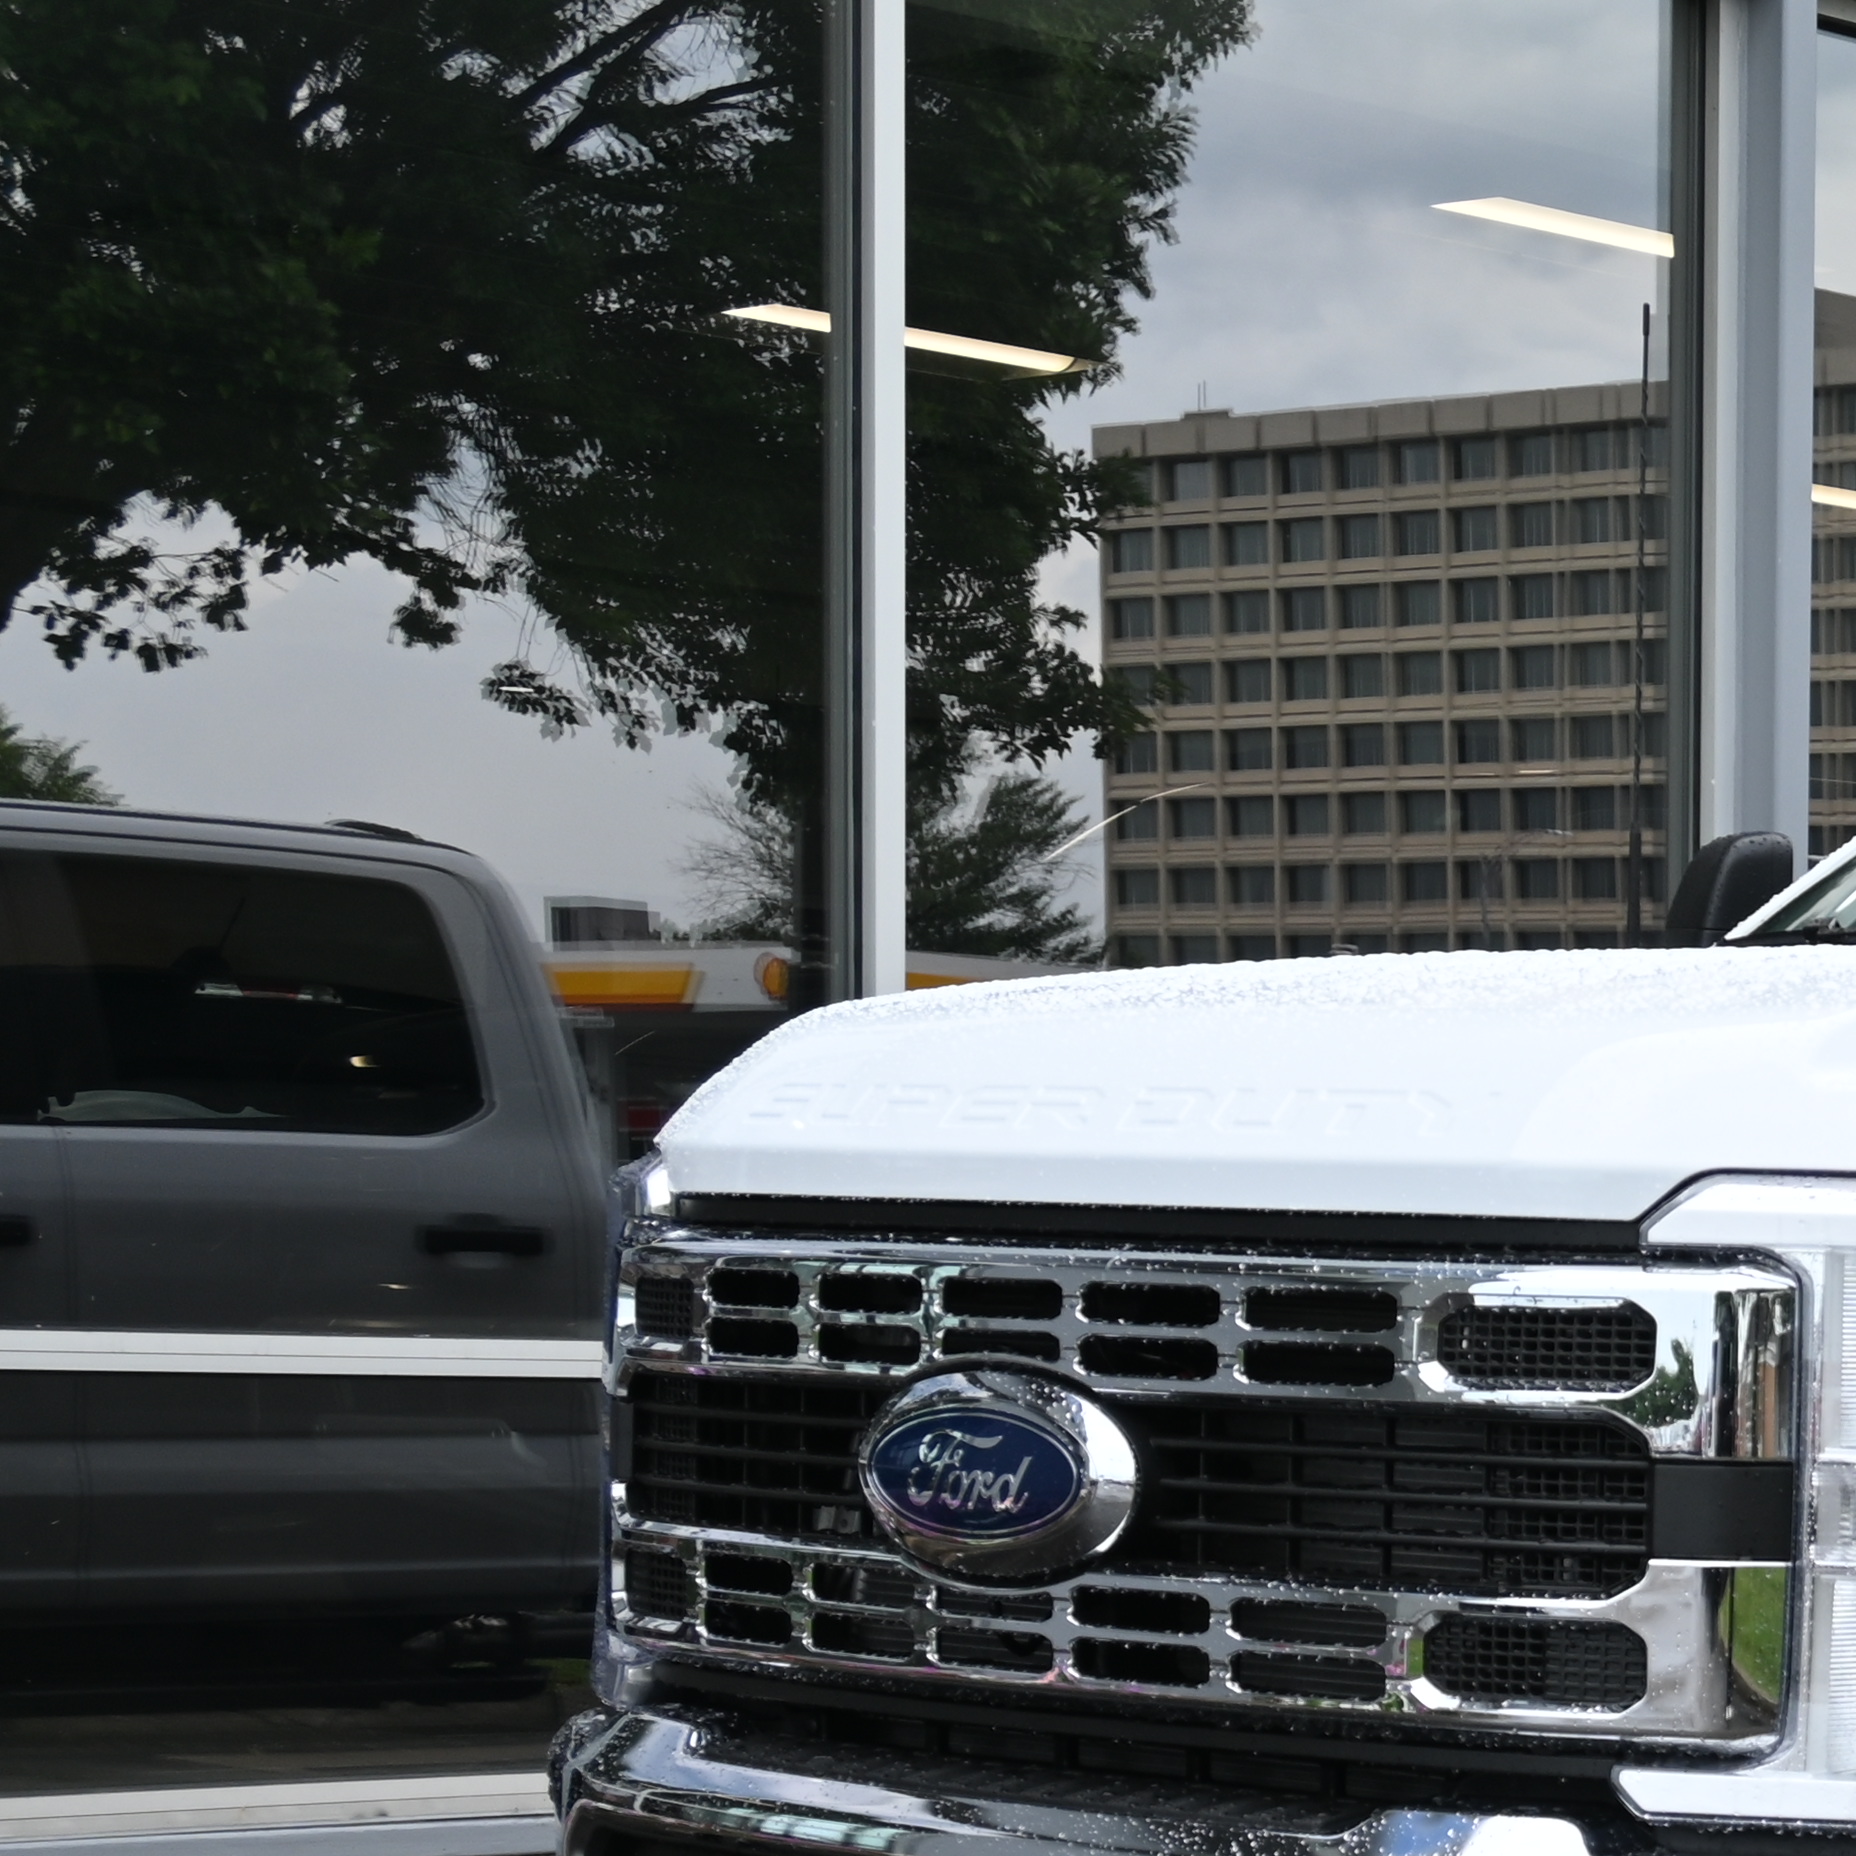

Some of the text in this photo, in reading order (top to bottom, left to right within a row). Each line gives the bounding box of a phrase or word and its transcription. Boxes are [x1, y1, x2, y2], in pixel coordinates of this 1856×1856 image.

[743, 1082, 1503, 1137] SUPER DUTY
[907, 1429, 1033, 1513] Ford
